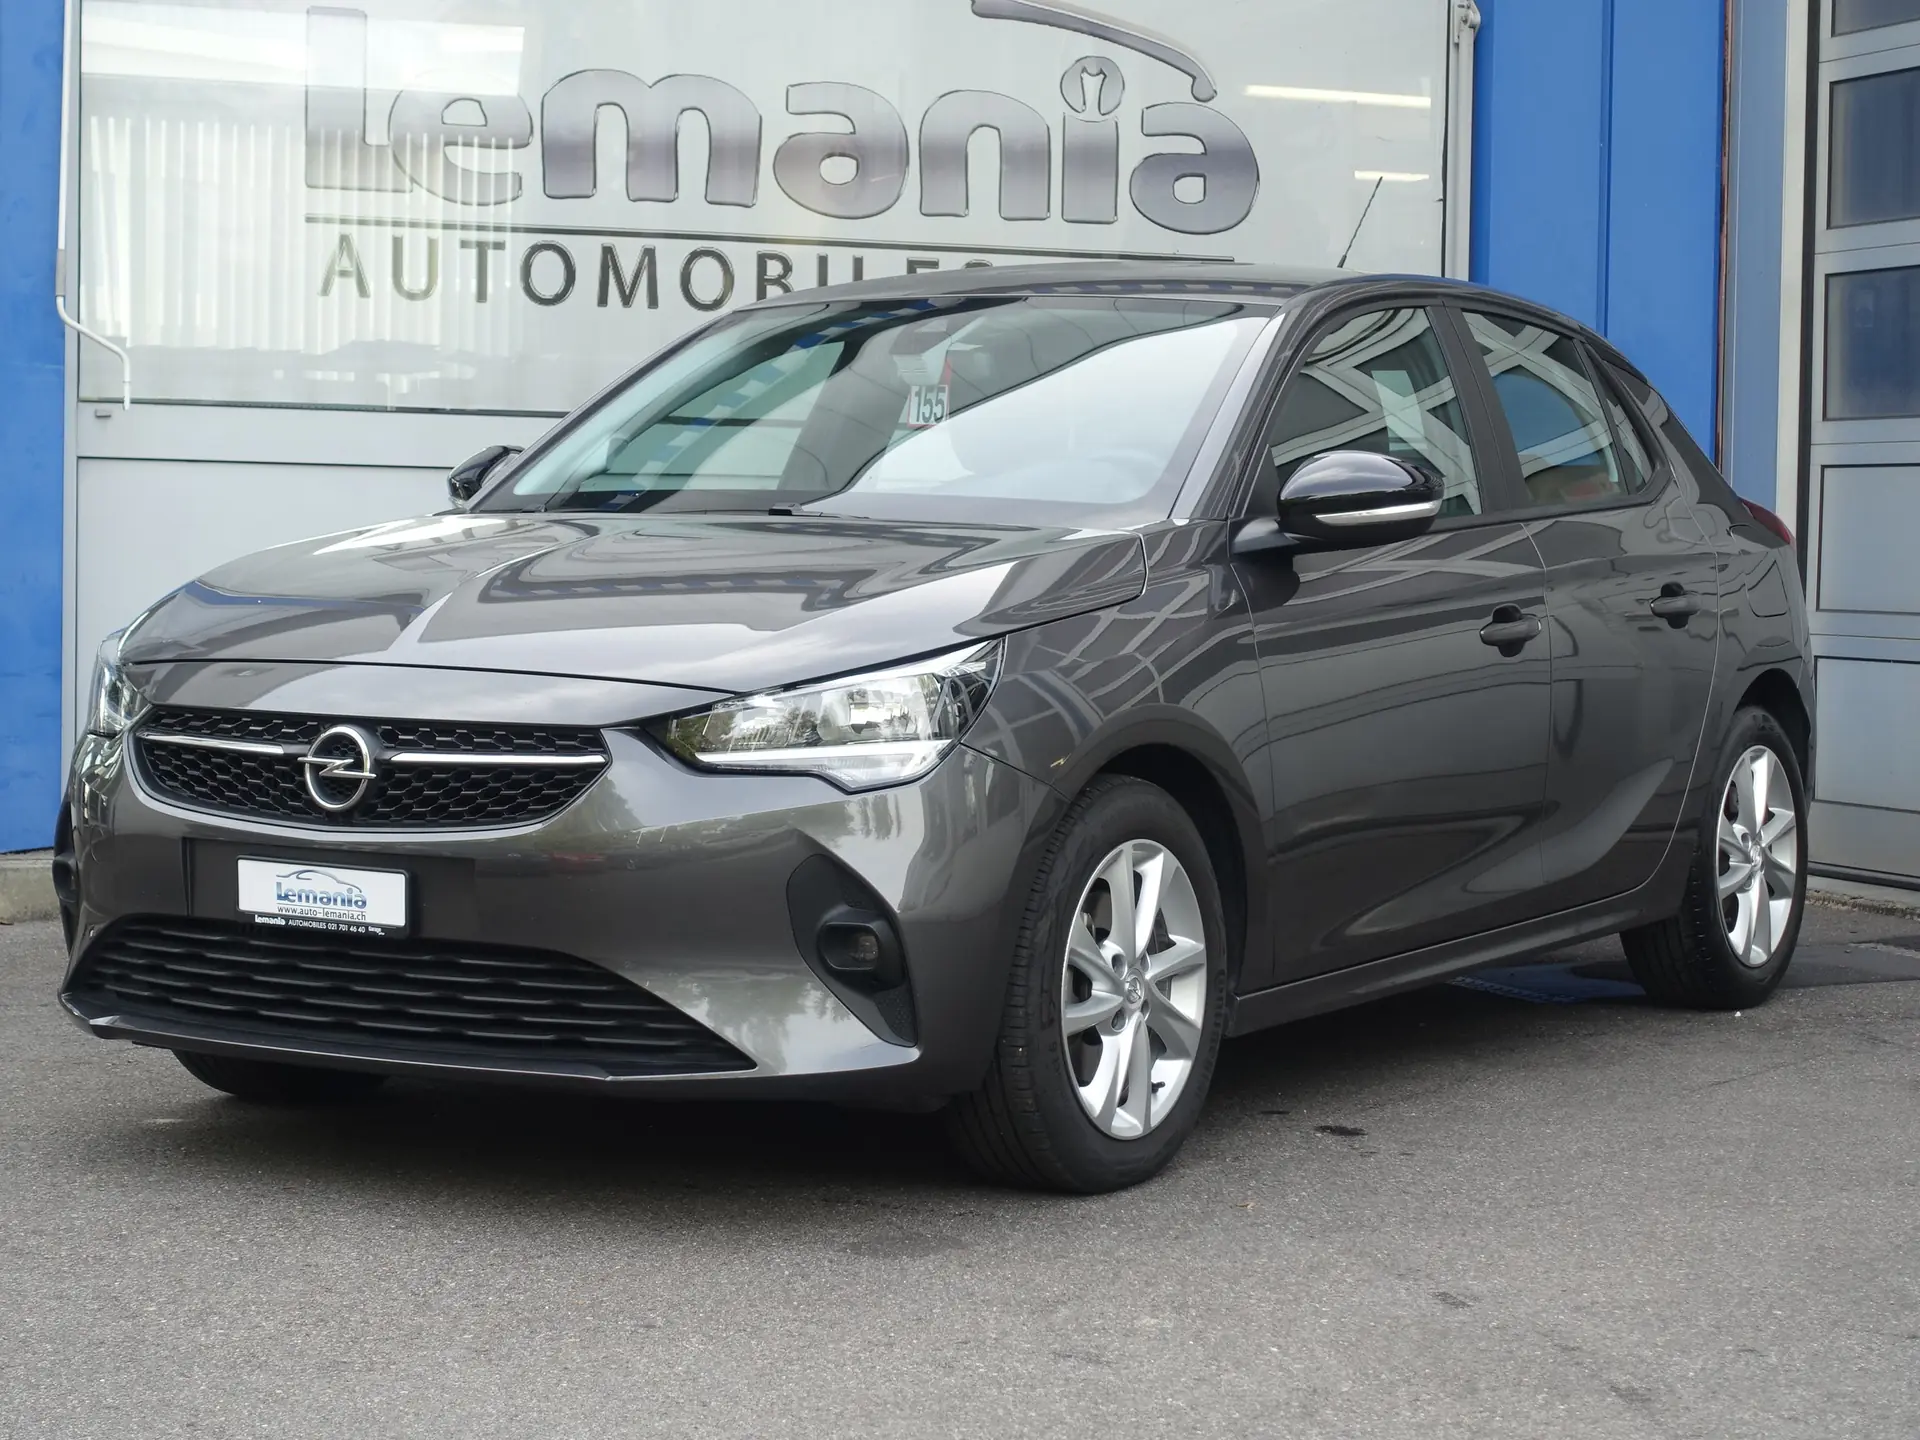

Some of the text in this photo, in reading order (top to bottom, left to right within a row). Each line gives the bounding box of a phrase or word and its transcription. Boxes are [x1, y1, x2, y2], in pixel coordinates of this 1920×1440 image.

[305, 6, 1261, 235] Lemania
[318, 232, 994, 312] AUTOMOBI
[914, 386, 945, 423] 155
[276, 881, 367, 909] Lemania
[255, 914, 286, 925] Lemania
[288, 919, 326, 929] AUTOMOBILES
[328, 922, 337, 930] 021
[338, 923, 348, 931] 701
[277, 906, 366, 921] www.auto-lemania.ch
